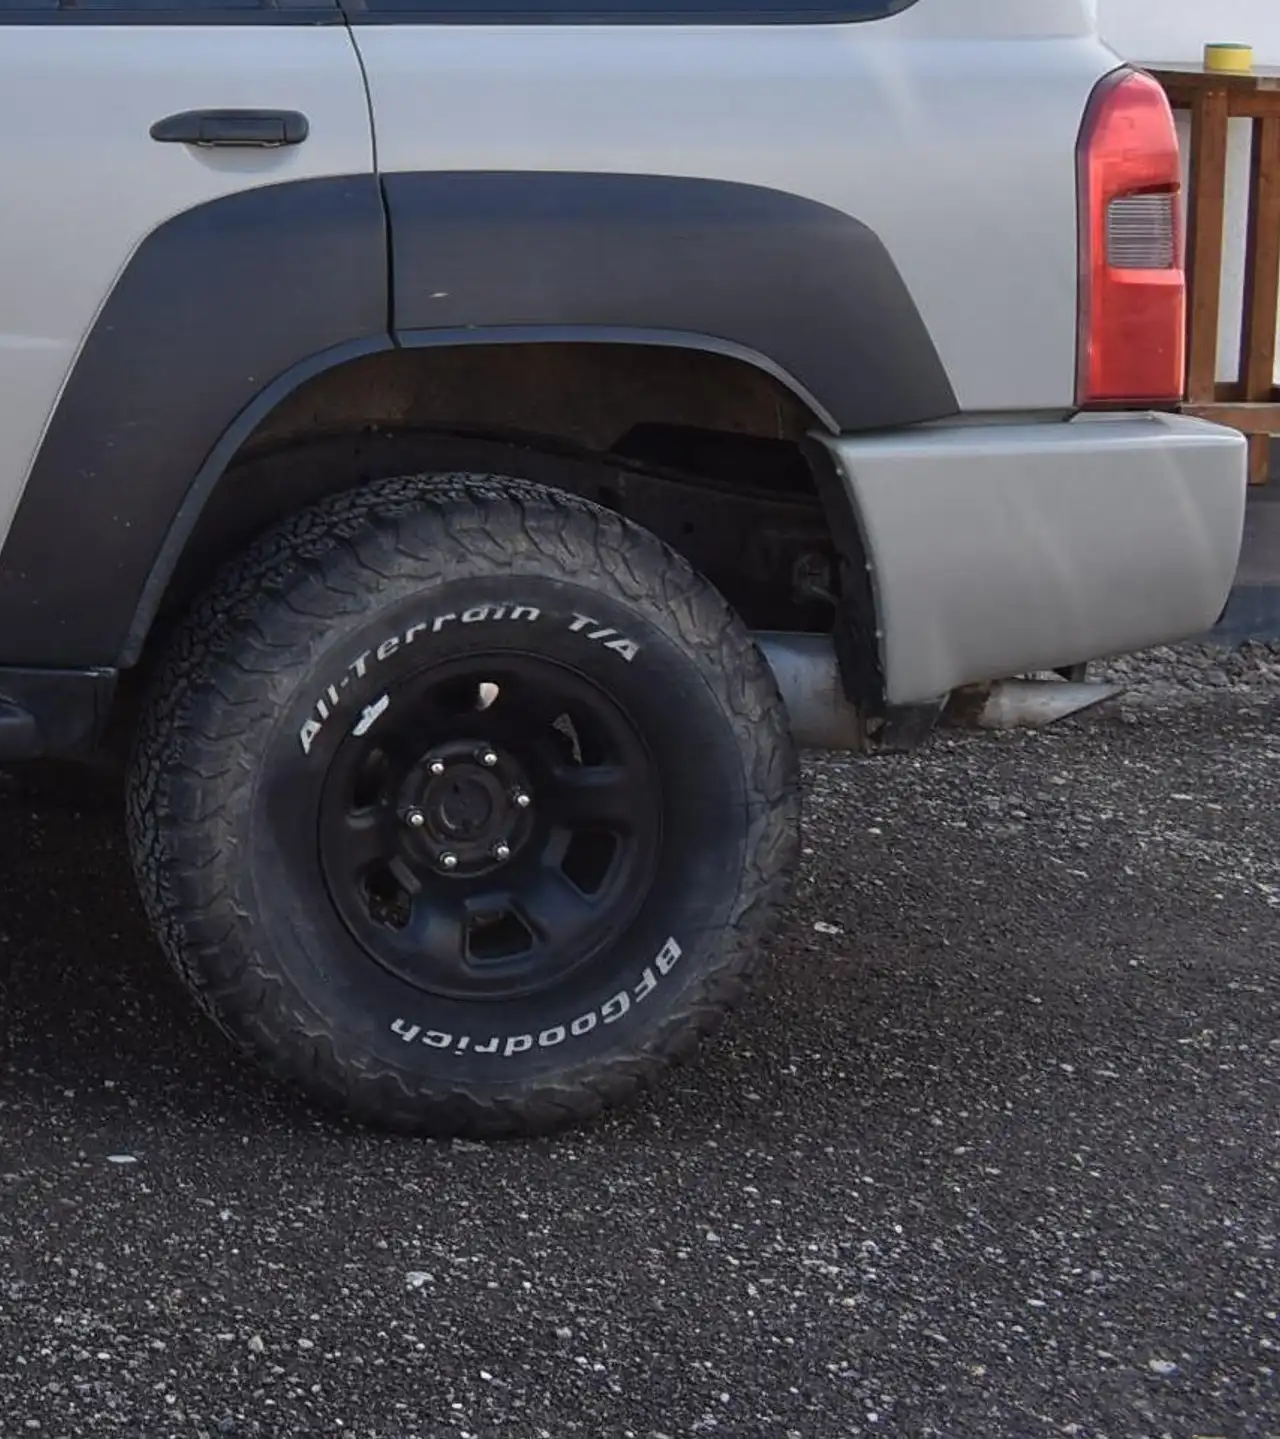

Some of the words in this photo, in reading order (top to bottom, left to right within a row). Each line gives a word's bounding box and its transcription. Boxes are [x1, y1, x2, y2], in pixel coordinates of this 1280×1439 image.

[299, 602, 541, 754] All-Terrain
[568, 611, 642, 662] T/A
[389, 935, 683, 1057] BFGoodrich
